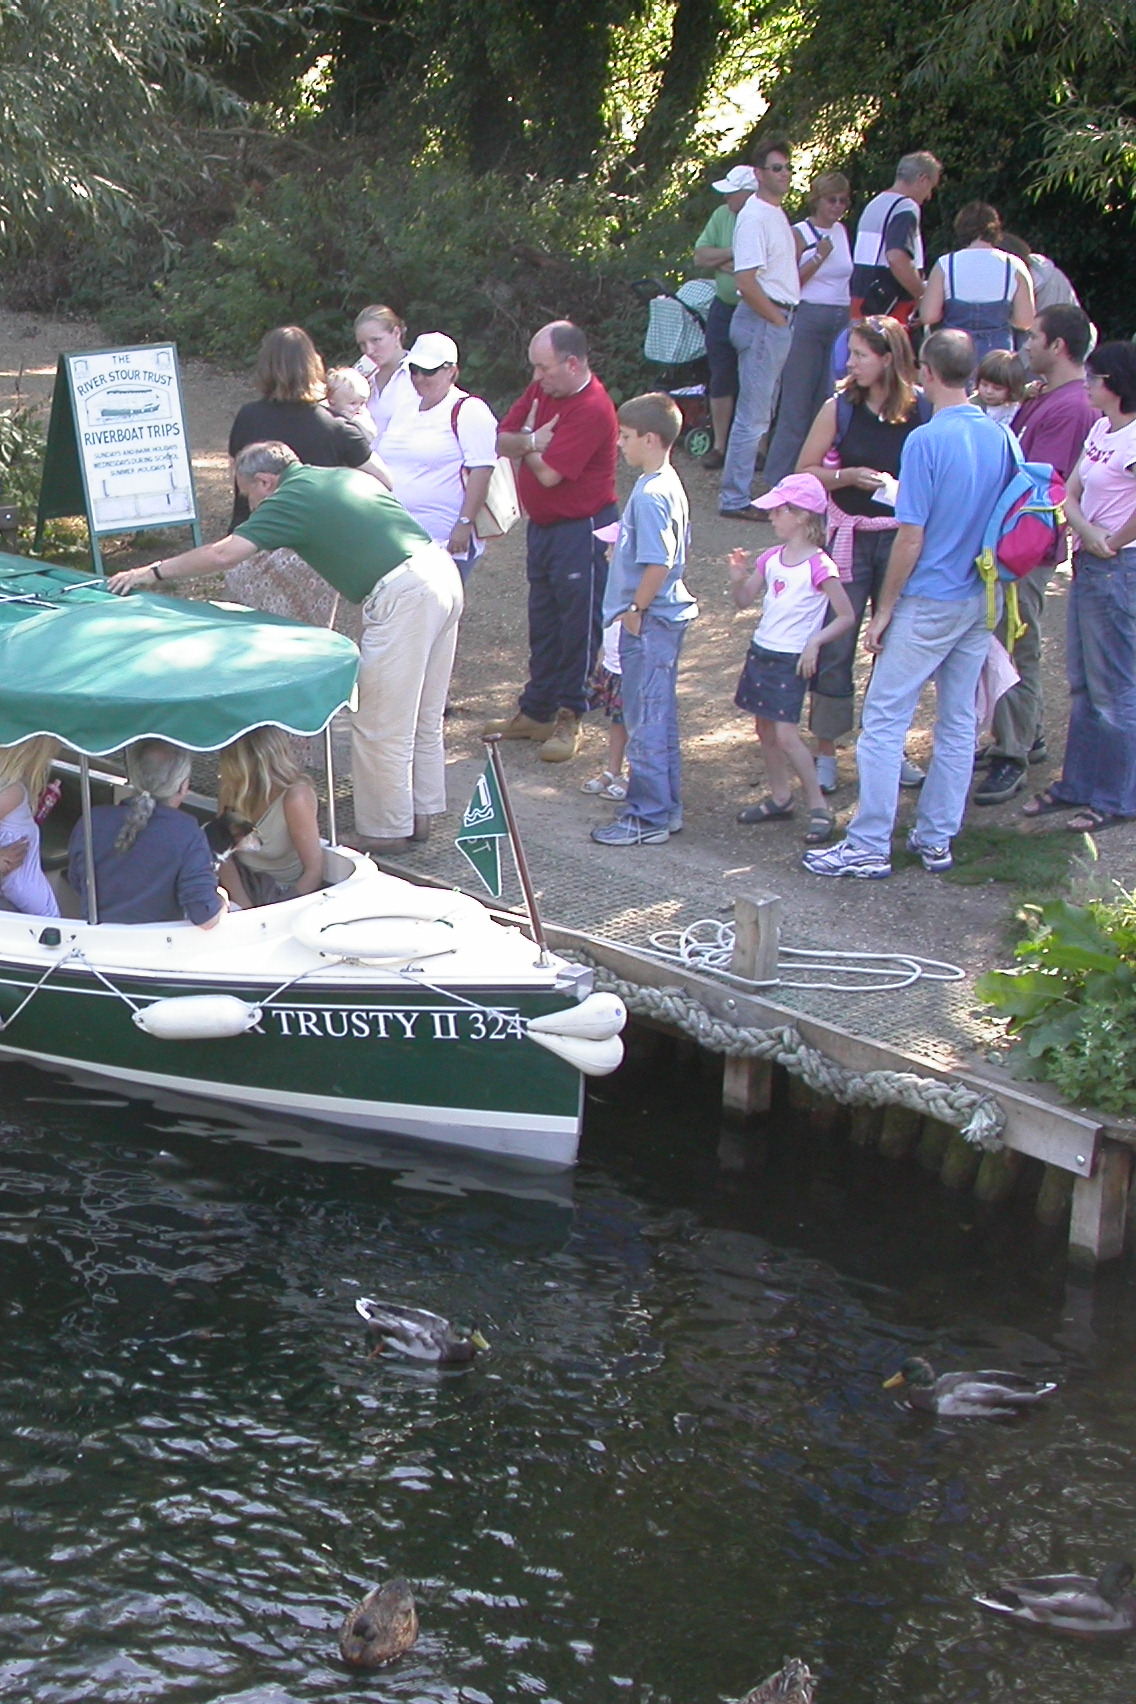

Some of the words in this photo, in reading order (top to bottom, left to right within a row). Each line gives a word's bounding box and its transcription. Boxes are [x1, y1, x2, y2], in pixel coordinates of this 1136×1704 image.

[112, 354, 131, 365] THE
[77, 374, 108, 396] RIVER
[108, 369, 140, 382] STOUR
[142, 370, 173, 386] TRUST
[84, 426, 144, 446] RIVERBOAT
[147, 422, 180, 438] TRIPS
[95, 450, 121, 459] SUNDAYS
[152, 444, 178, 452] HOLIDAYS
[94, 459, 131, 468] WEDNESDAYS
[132, 456, 153, 464] DURING
[111, 468, 134, 476] SUMMER
[137, 464, 166, 472] HOLIDAYS
[272, 1010, 420, 1039] TRUSTY
[430, 1012, 460, 1039] II
[468, 1012, 522, 1040] 324
